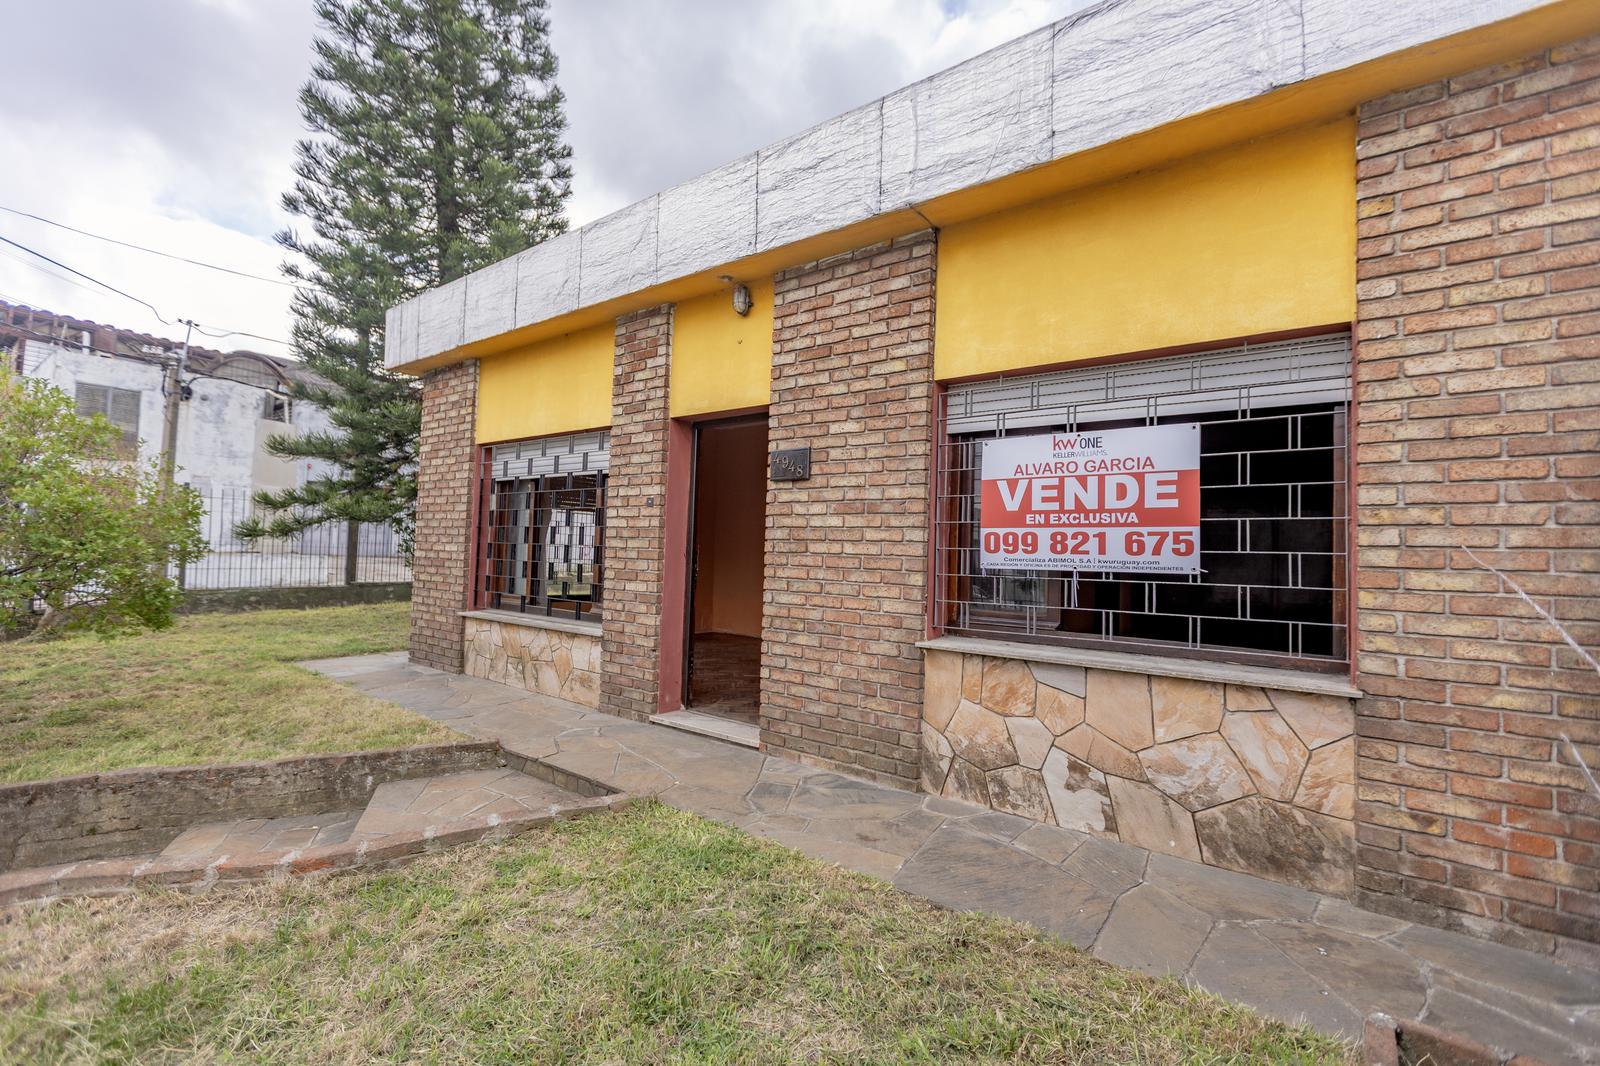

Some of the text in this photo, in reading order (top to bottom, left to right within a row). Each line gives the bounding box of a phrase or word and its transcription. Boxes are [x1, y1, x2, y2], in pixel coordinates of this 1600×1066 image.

[1053, 435, 1102, 451] kw ONE
[773, 452, 803, 477] 4948
[1014, 456, 1155, 476] ALVARO GARCIA
[996, 472, 1179, 512] VENDE
[1026, 513, 1138, 524] EN EXCLUSIVA
[984, 531, 1194, 556] 099 821 675
